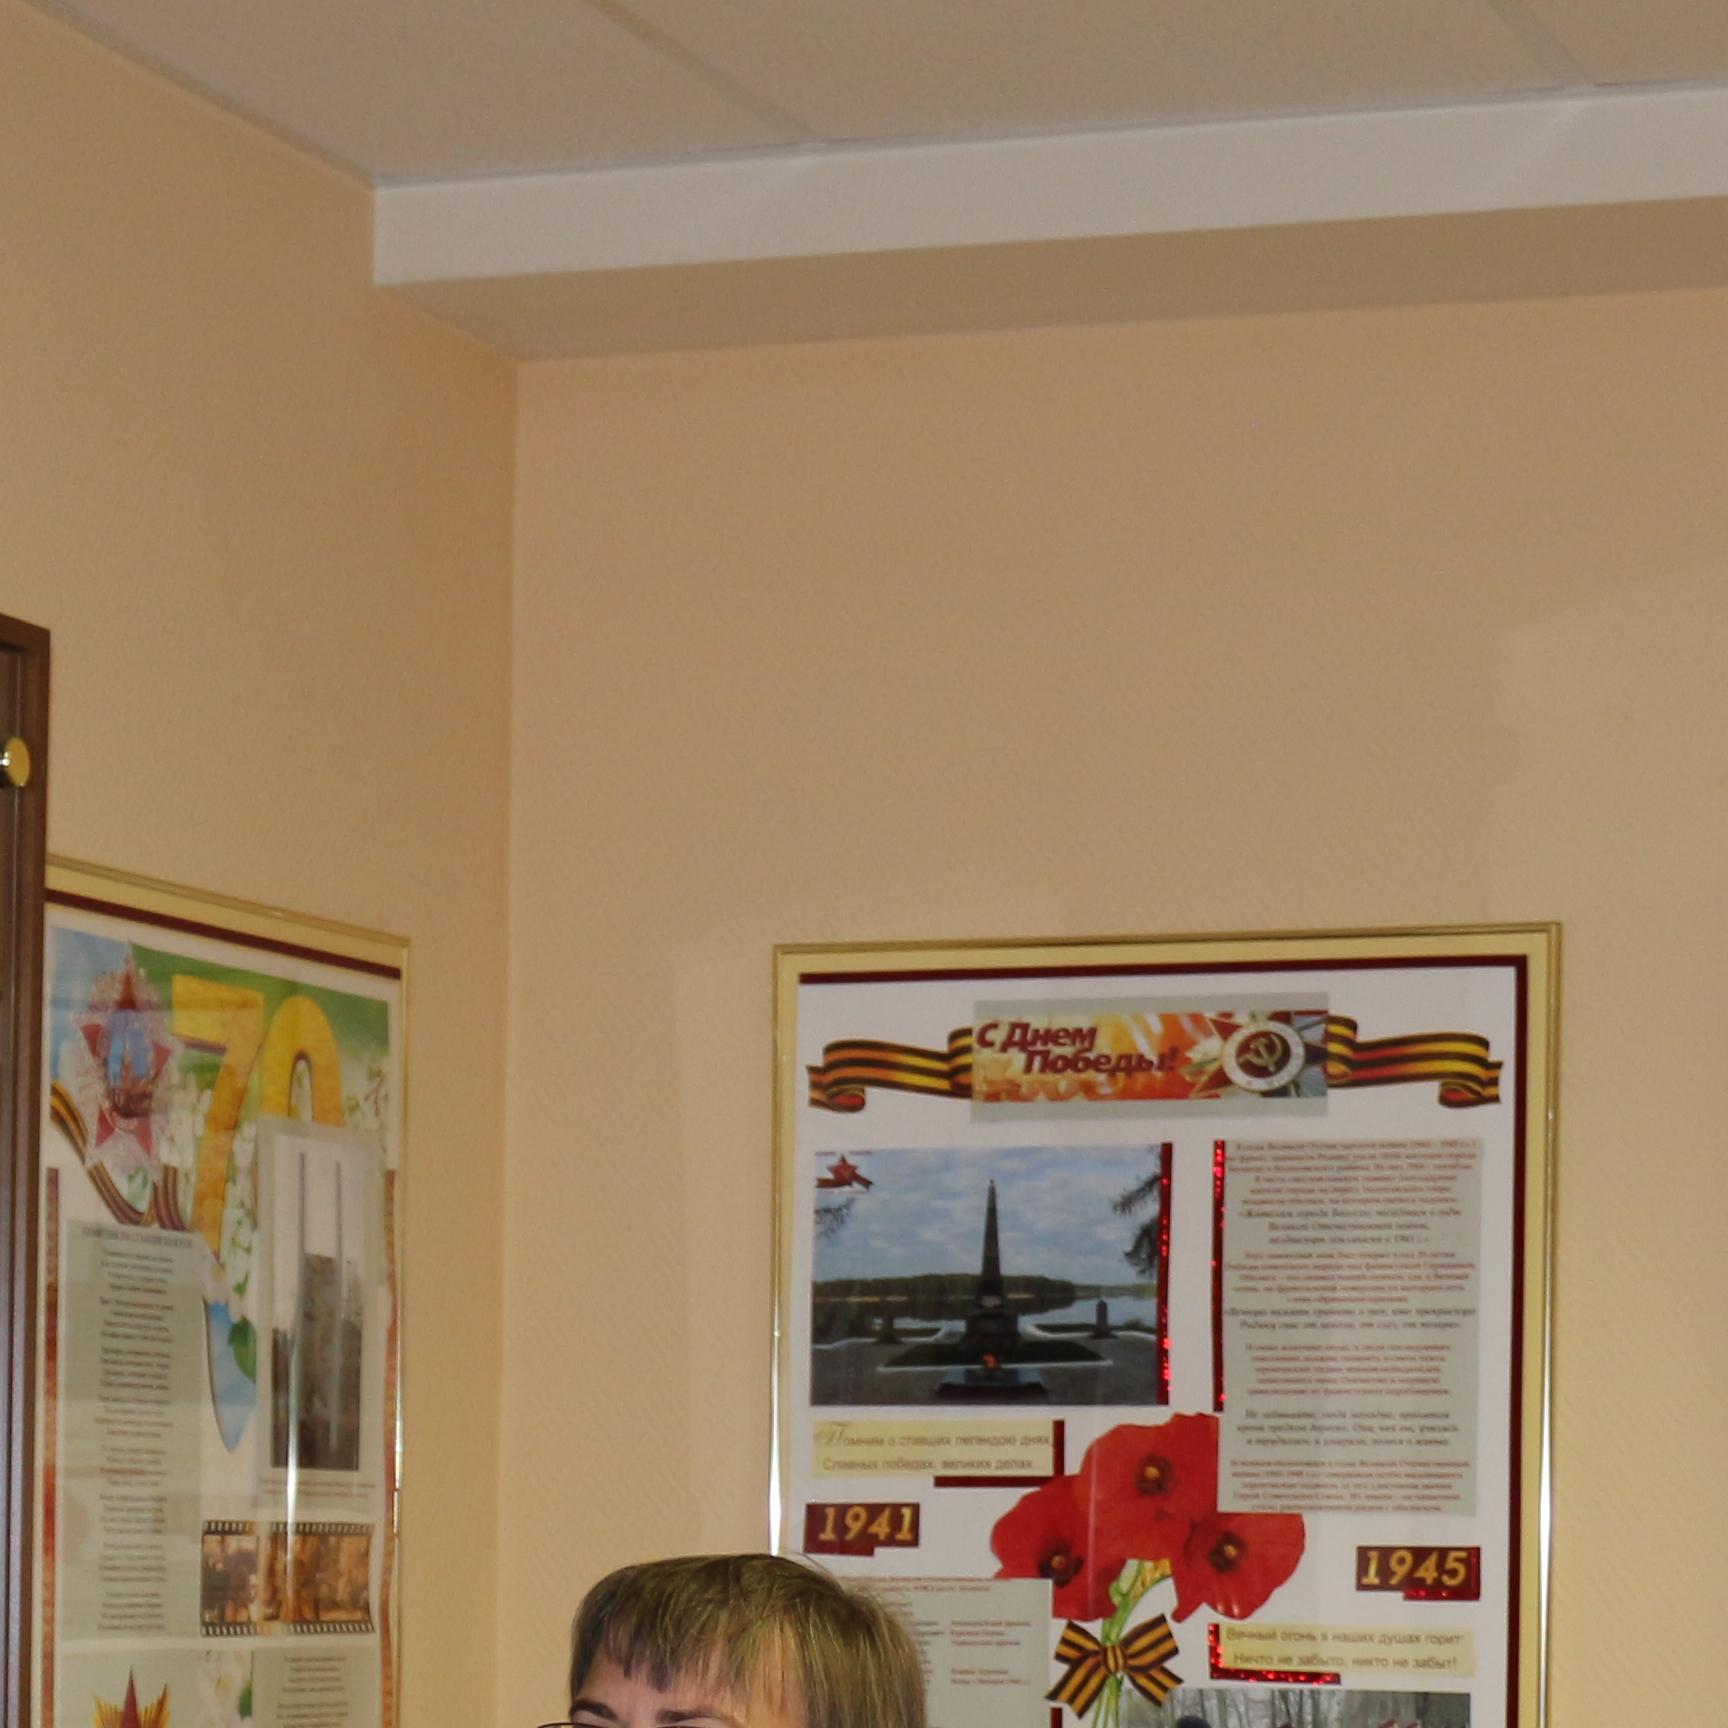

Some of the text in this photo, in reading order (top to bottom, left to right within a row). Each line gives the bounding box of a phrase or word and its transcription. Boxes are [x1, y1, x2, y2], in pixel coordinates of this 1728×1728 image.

[975, 1021, 1098, 1052] С Днем
[1023, 1048, 1178, 1078] Победы!
[818, 1506, 914, 1541] 1941
[1360, 1550, 1469, 1587] 1945
